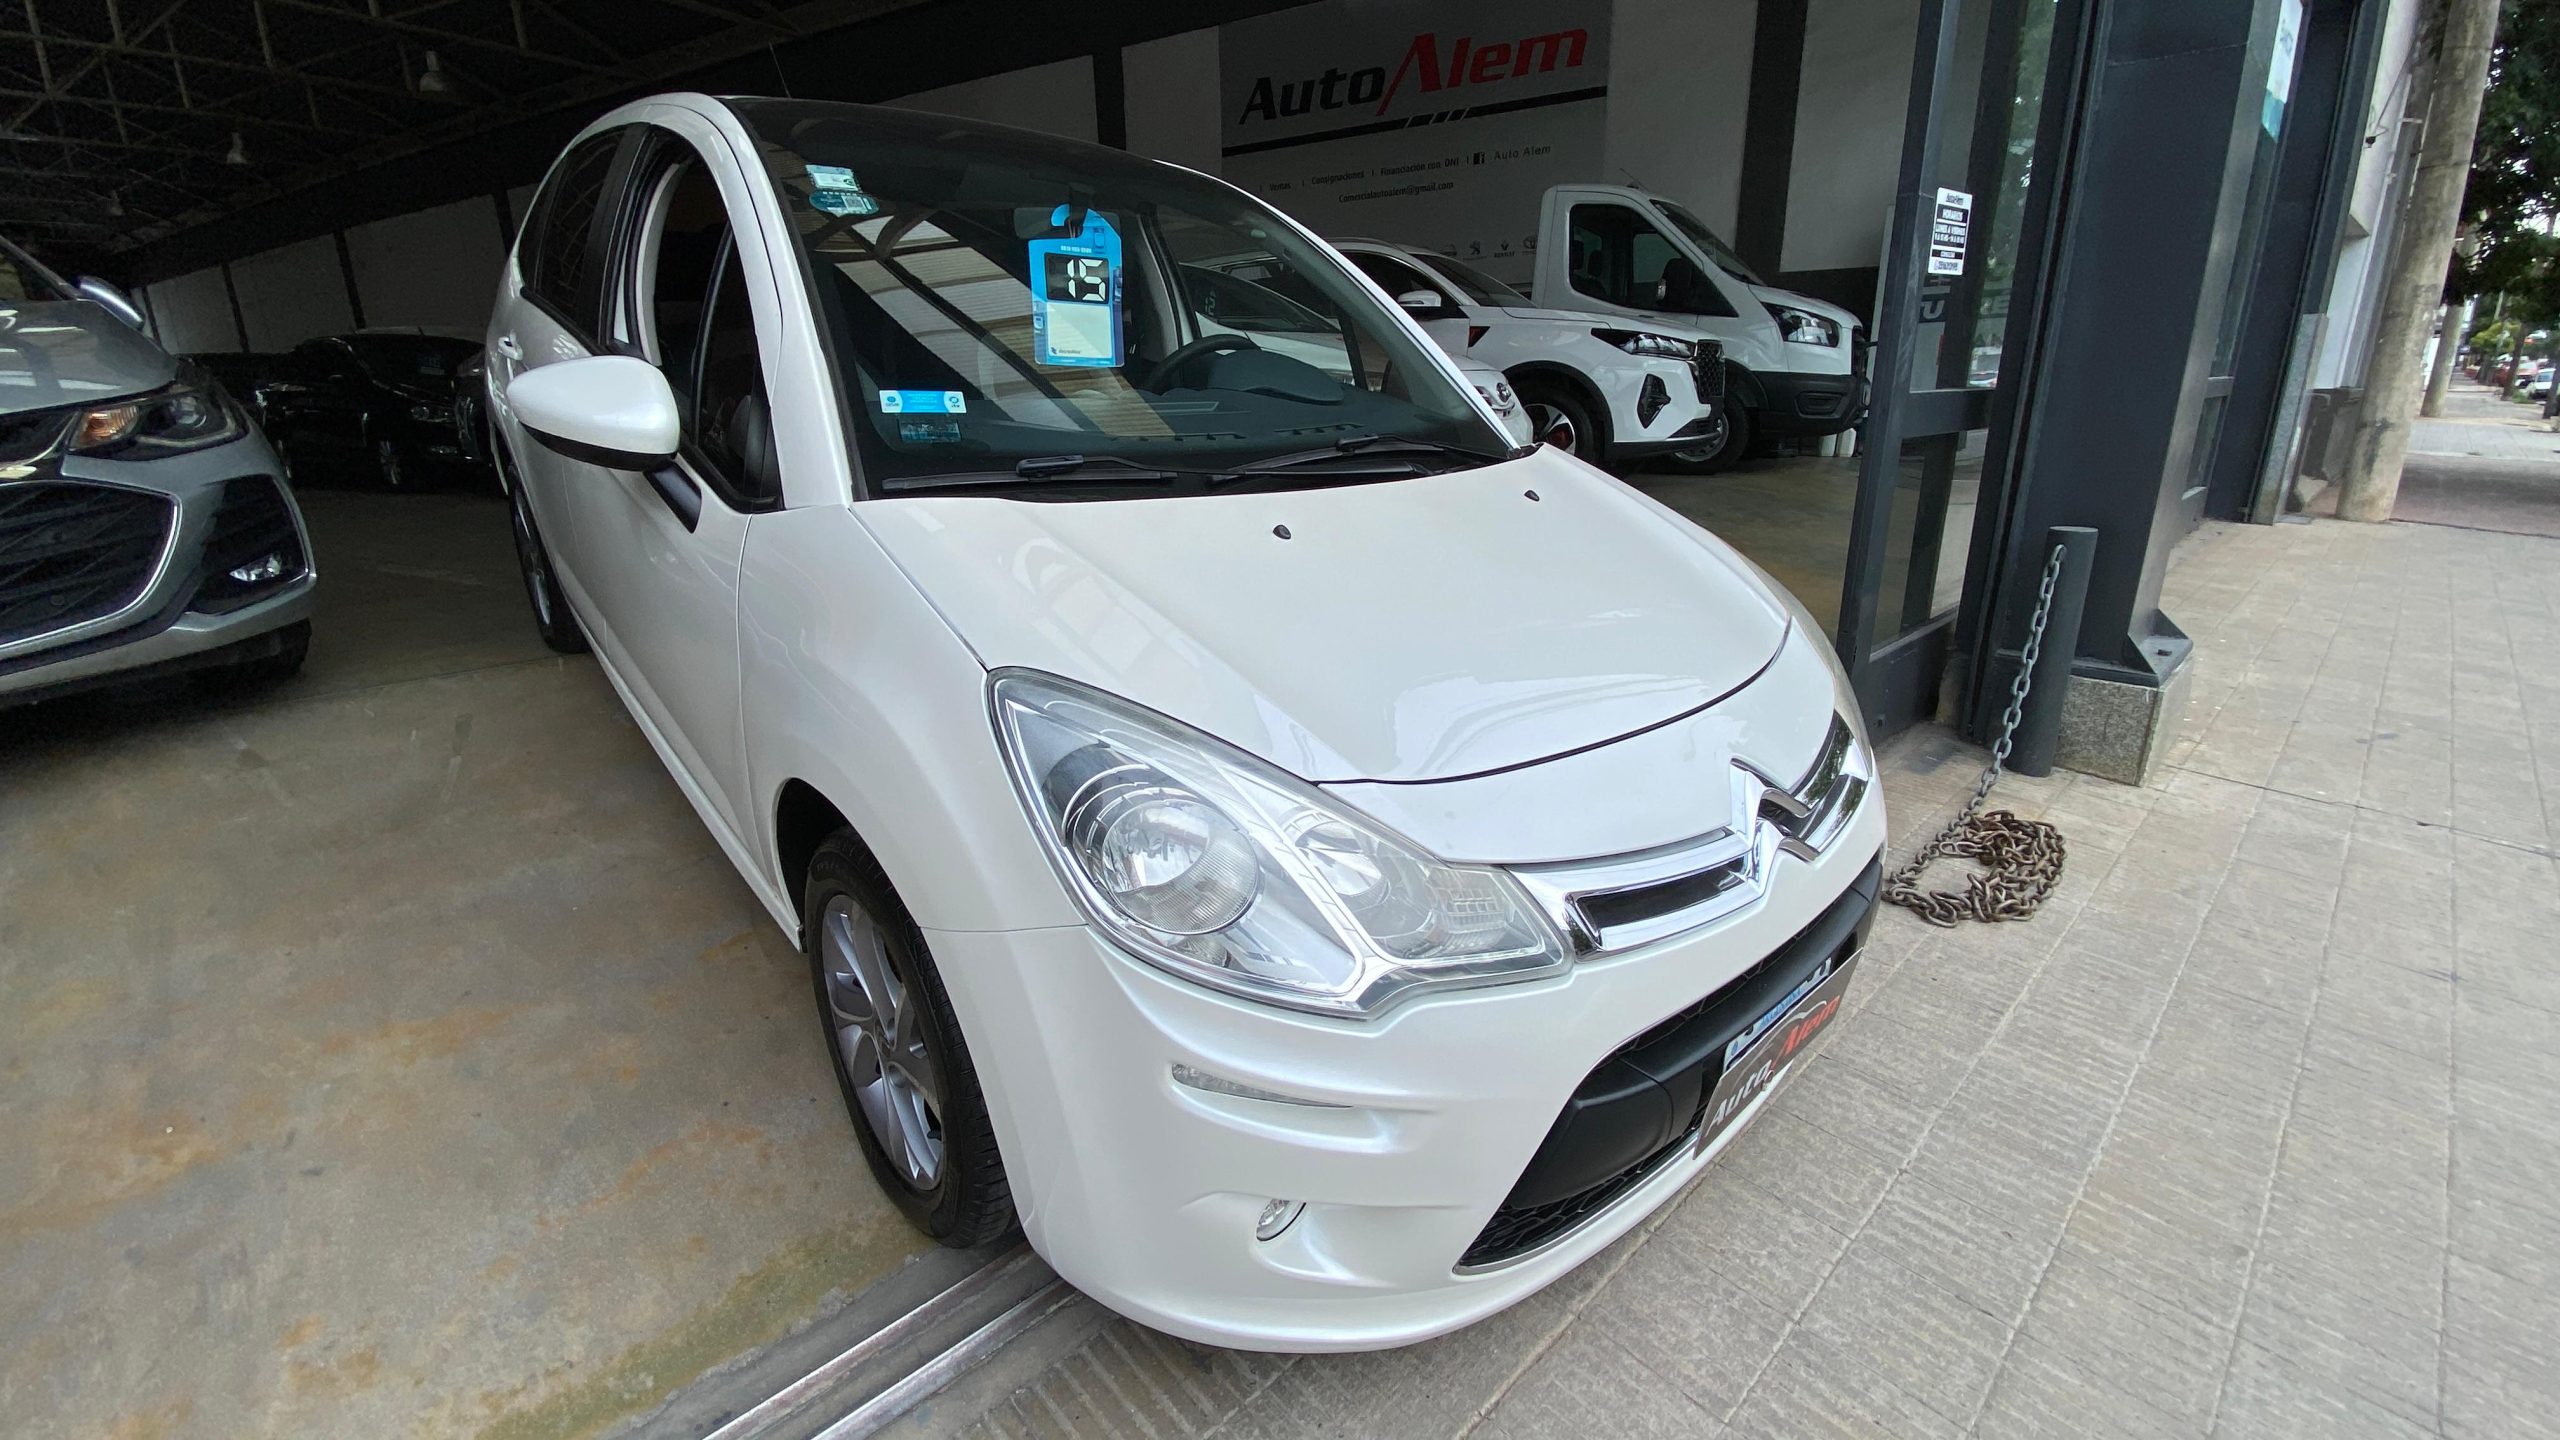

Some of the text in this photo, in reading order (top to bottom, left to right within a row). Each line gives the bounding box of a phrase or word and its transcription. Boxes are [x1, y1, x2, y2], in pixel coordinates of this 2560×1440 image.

[1428, 162, 1441, 171] con
[1494, 150, 1519, 161] Auto
[1523, 145, 1551, 157] Alem
[1067, 258, 1106, 302] 15
